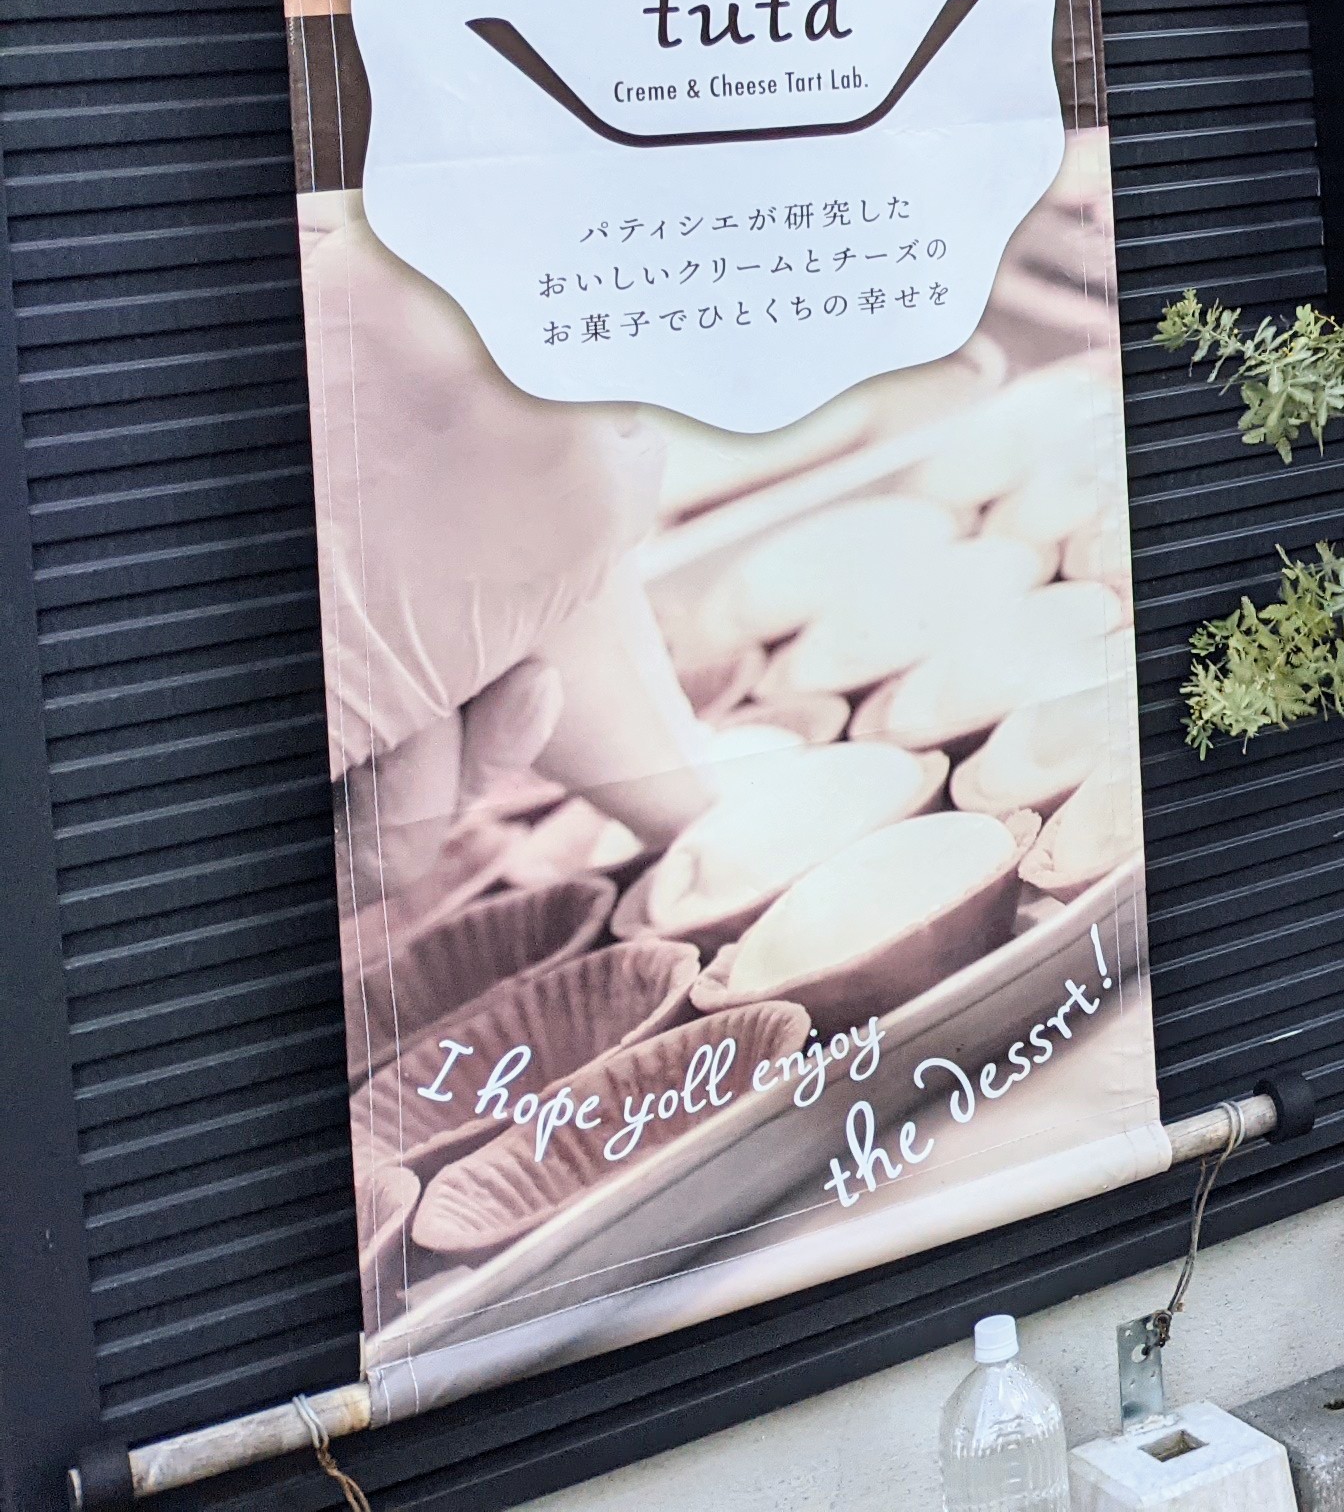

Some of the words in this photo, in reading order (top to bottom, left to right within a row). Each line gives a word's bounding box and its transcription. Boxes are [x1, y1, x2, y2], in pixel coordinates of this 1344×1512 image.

[613, 80, 678, 103] Creme
[686, 77, 701, 99] &
[709, 74, 778, 98] Cheese
[784, 69, 823, 94] Tart
[829, 65, 869, 90] Lab.
[580, 195, 911, 244] パティシエが研究した
[539, 238, 948, 299] おいしいクリームとチーズの
[543, 281, 950, 346] お菓子でひとくちの幸せを
[417, 1039, 475, 1103] I
[475, 1045, 601, 1163] hope
[603, 1038, 738, 1161] yoll
[753, 1016, 885, 1107] enjoy
[824, 1100, 936, 1208] the
